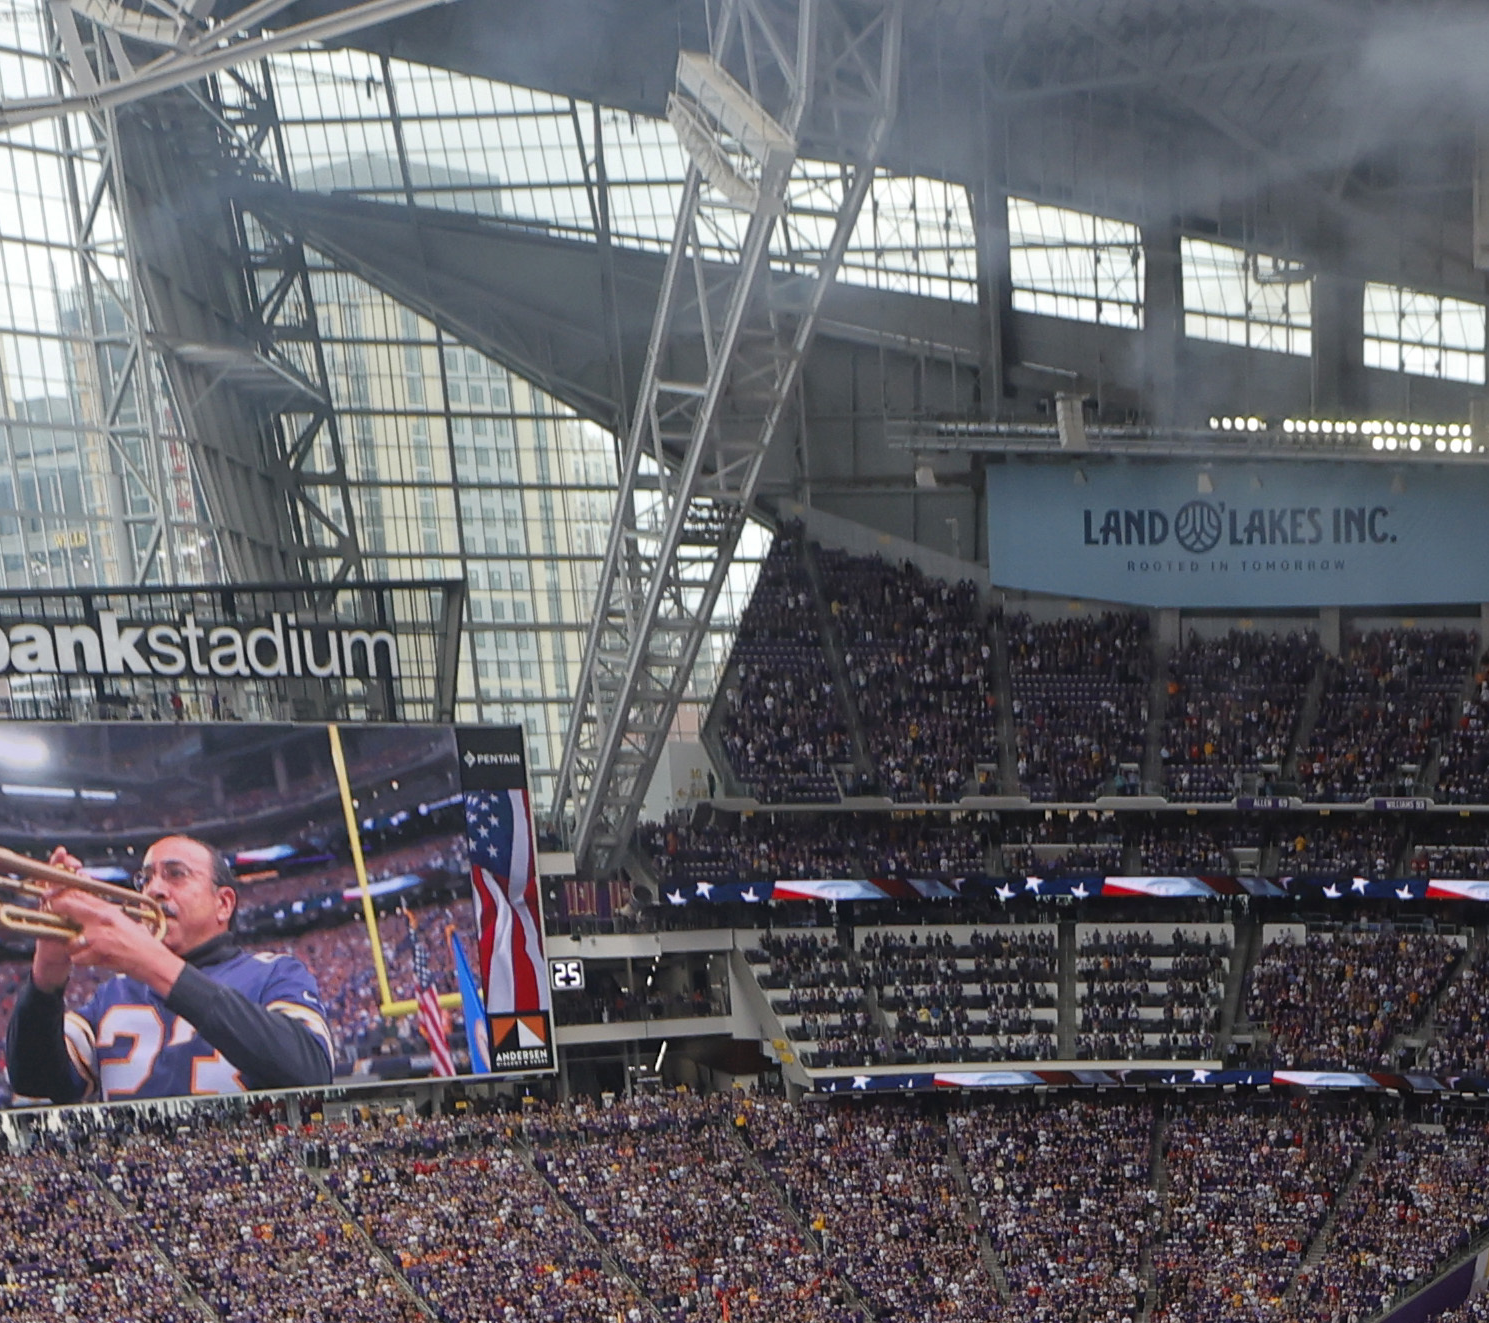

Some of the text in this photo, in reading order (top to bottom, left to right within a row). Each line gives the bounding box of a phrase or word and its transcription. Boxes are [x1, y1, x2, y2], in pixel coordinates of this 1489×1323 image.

[1083, 508, 1170, 545] LAND
[1331, 506, 1398, 545] INC.
[1127, 559, 1346, 573] ROOTED IN TOMORROW
[477, 753, 521, 765] PENTAIR
[554, 962, 581, 987] 25
[495, 1050, 548, 1061] ANDERSEN
